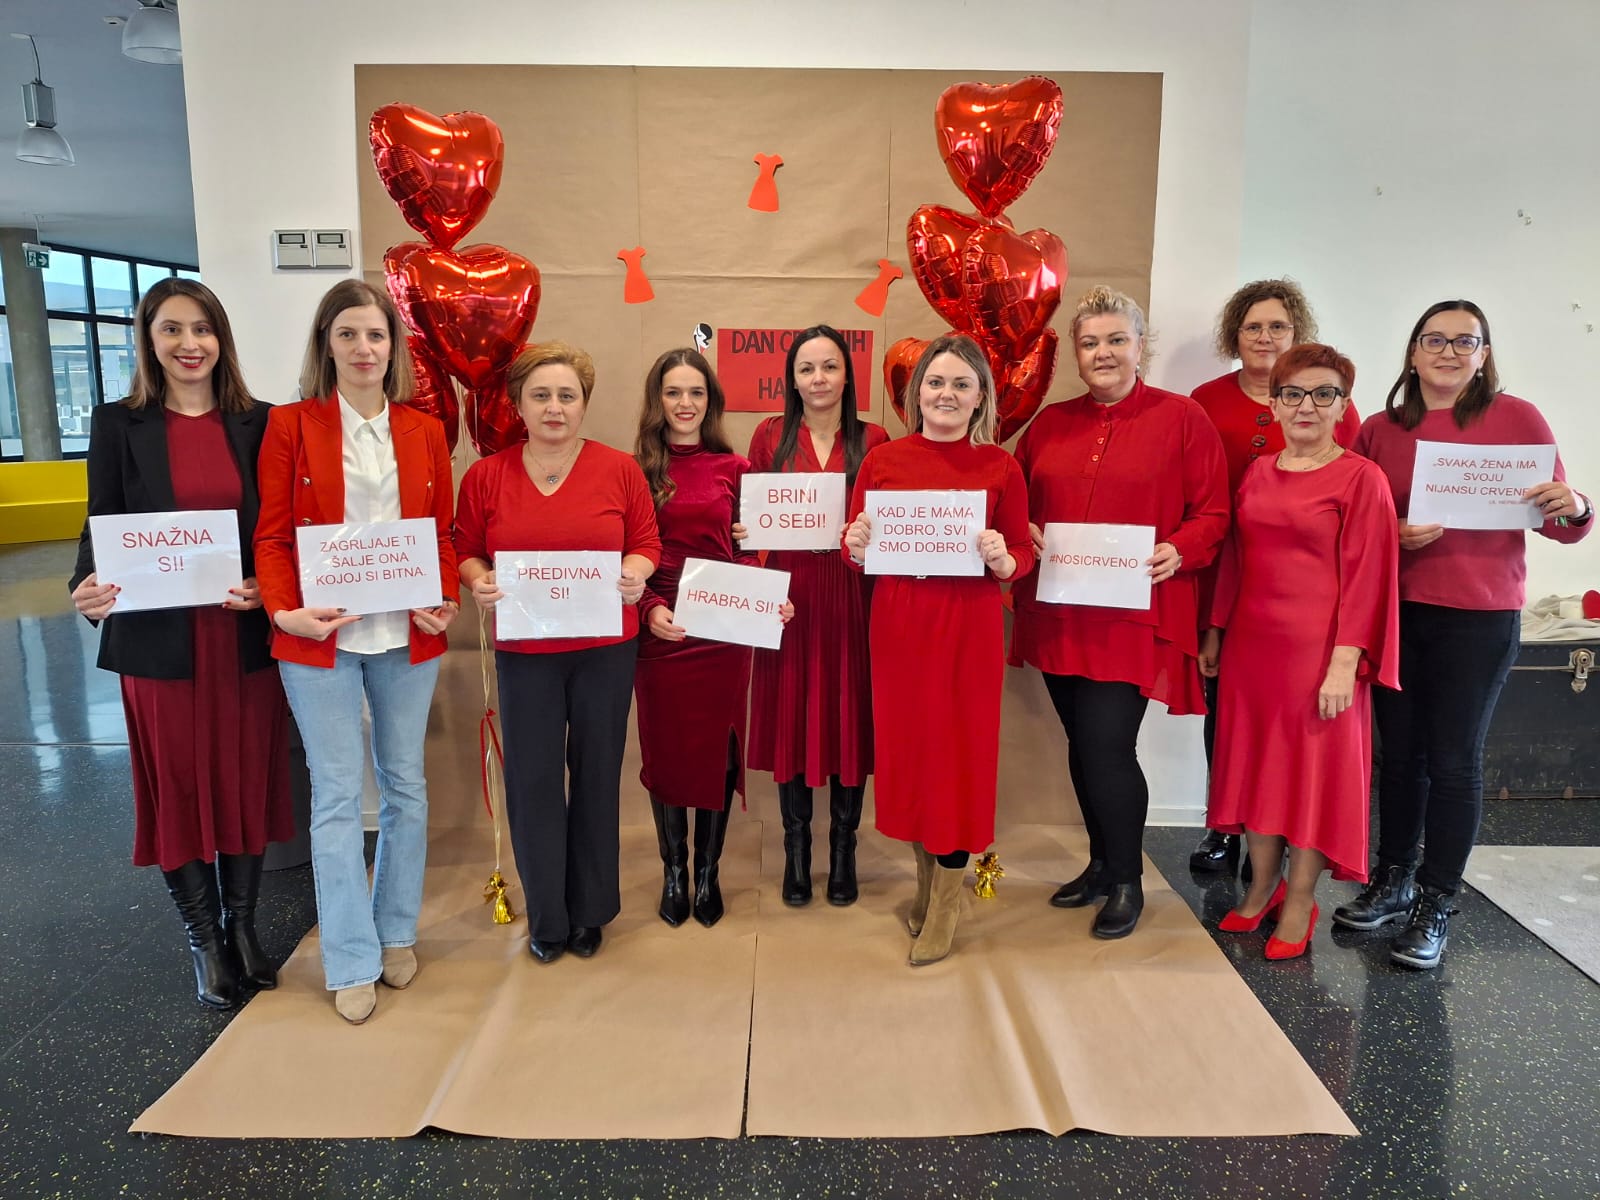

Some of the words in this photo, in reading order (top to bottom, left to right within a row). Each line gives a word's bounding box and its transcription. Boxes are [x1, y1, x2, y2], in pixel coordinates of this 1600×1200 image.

[732, 330, 775, 354] DAN
[1480, 459, 1513, 469] ŽENA
[1516, 460, 1537, 469] IMA
[1463, 472, 1504, 481] SVOJU
[768, 488, 817, 504] BRINI
[1426, 484, 1477, 495] NIJANSU
[877, 506, 906, 518] KAD
[910, 506, 926, 518] JE
[931, 506, 974, 518] MAMA
[759, 513, 773, 529] O
[779, 513, 826, 529] SEBI!
[122, 526, 214, 549] SNAŽNA
[883, 524, 939, 537] DOBRO,
[943, 524, 967, 536] SVI
[320, 536, 401, 553] ZAGRLJAJE
[404, 535, 416, 546] TI
[879, 541, 911, 553] SMO
[158, 555, 185, 573] SI!
[332, 554, 374, 568] ŠALJE
[378, 552, 409, 564] ONA
[1050, 553, 1138, 569] #NOSICRVENO
[316, 572, 361, 586] KOJOJ
[365, 570, 379, 582] SI
[383, 566, 427, 580] BITNA.
[518, 567, 602, 580] PREDIVNA
[550, 586, 570, 599] SI!
[687, 588, 750, 610] HRABRA
[755, 599, 774, 614] SI!
